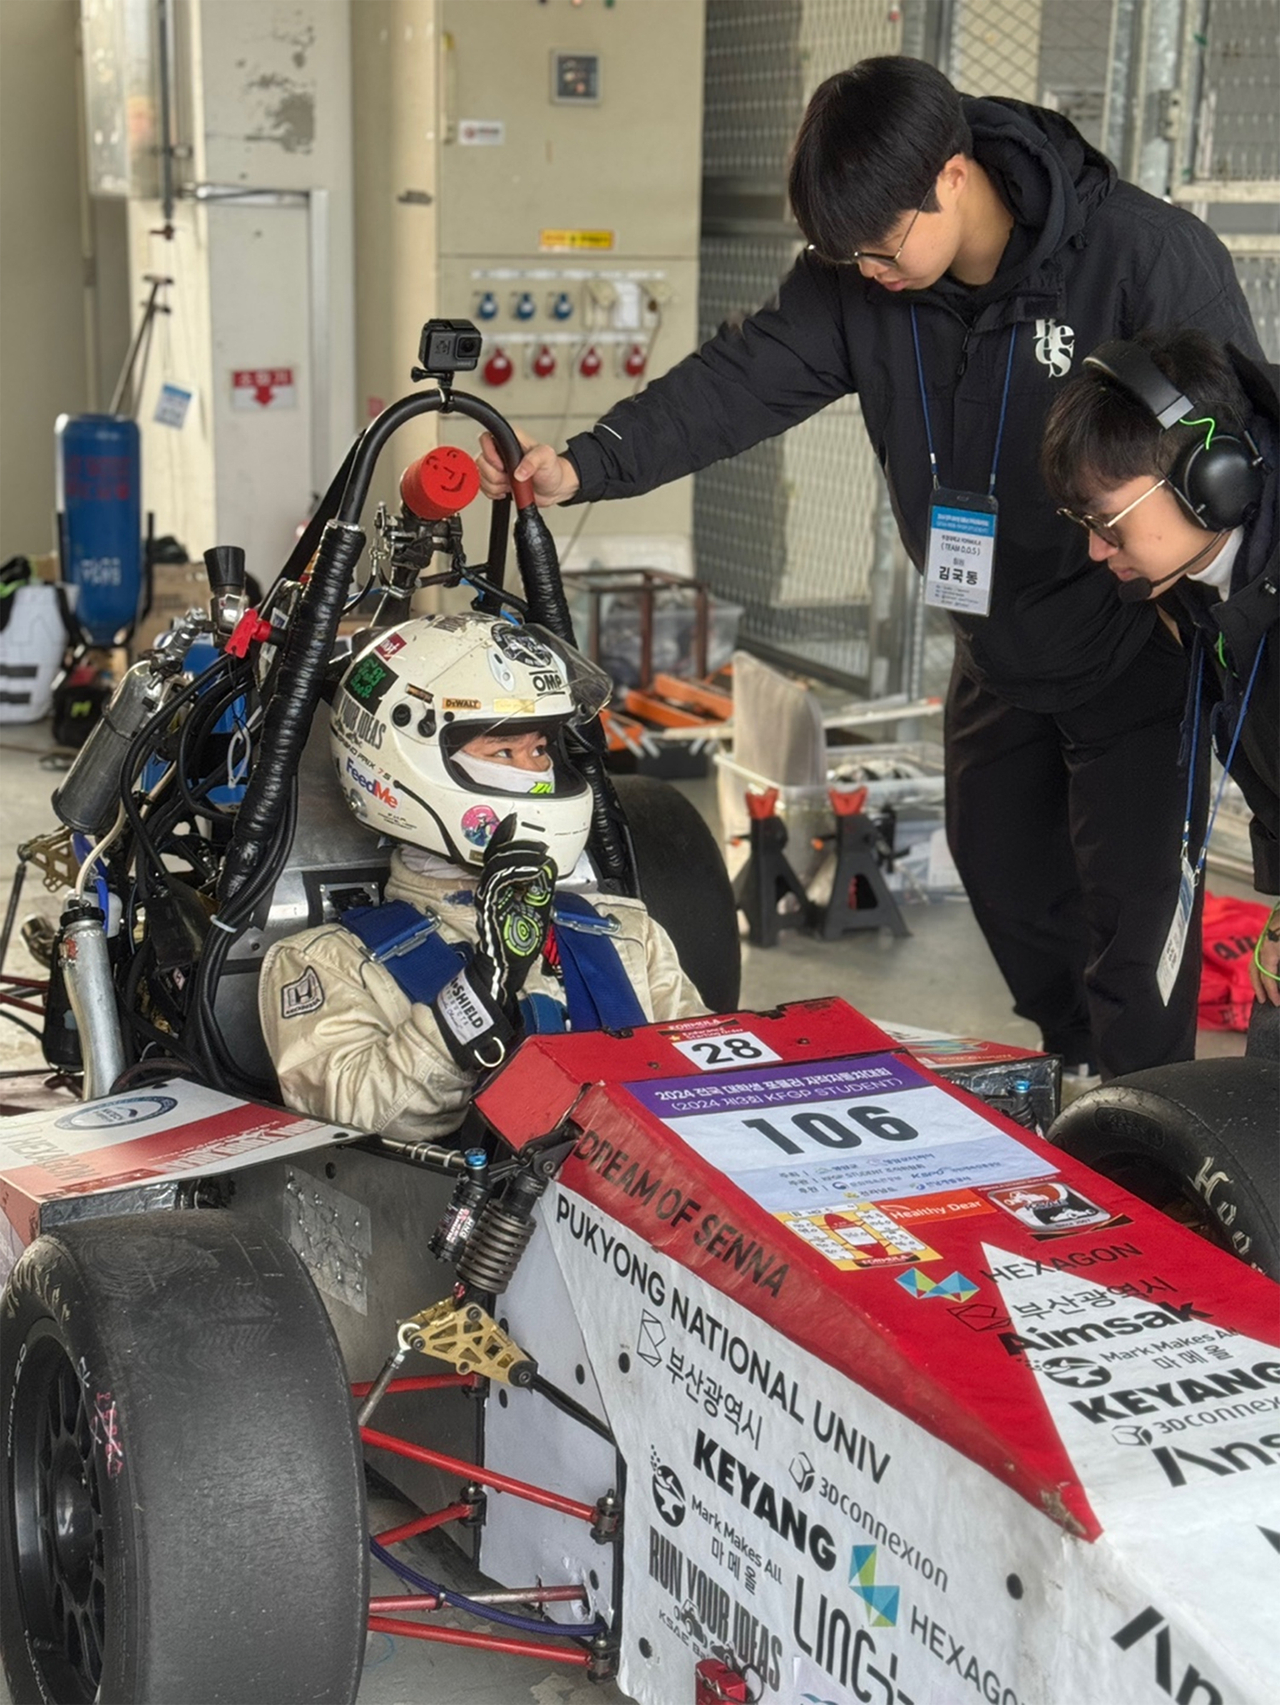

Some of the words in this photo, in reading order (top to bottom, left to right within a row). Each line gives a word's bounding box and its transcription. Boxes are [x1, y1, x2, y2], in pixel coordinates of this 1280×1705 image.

[532, 674, 562, 692] OMP
[346, 757, 398, 809] FeedMe
[691, 1038, 763, 1065] 28
[654, 1088, 694, 1101] 2024
[723, 1082, 763, 1094] 대학생
[671, 1098, 720, 1112] (2024
[814, 1077, 904, 1097] STUDENT)
[741, 1106, 919, 1155] 106
[573, 1129, 664, 1207] DREAM
[655, 1183, 701, 1228] OF
[693, 1214, 790, 1299] SENNA
[890, 1203, 946, 1220] Healthy
[947, 1200, 982, 1212] Dear
[979, 1242, 1144, 1283] HEXAGON
[1012, 1276, 1179, 1320] 부산광역시
[557, 1194, 667, 1307] PUKYONG
[670, 1287, 805, 1425] NATIONAL
[813, 1399, 891, 1485] UNIV
[997, 1302, 1214, 1356] Aimsak
[1100, 1345, 1152, 1364] Mark
[1153, 1332, 1215, 1354] Makes
[666, 1346, 763, 1450] 부산광역시
[1068, 1361, 1280, 1424] KEYANG
[693, 1428, 837, 1572] KEYANG
[691, 1495, 722, 1533] Mark
[723, 1521, 762, 1568] Makes
[649, 1524, 683, 1603] RUN
[686, 1557, 730, 1645] YOUR
[733, 1600, 783, 1692] IDEAS
[910, 1604, 1024, 1705] HEXAGO
